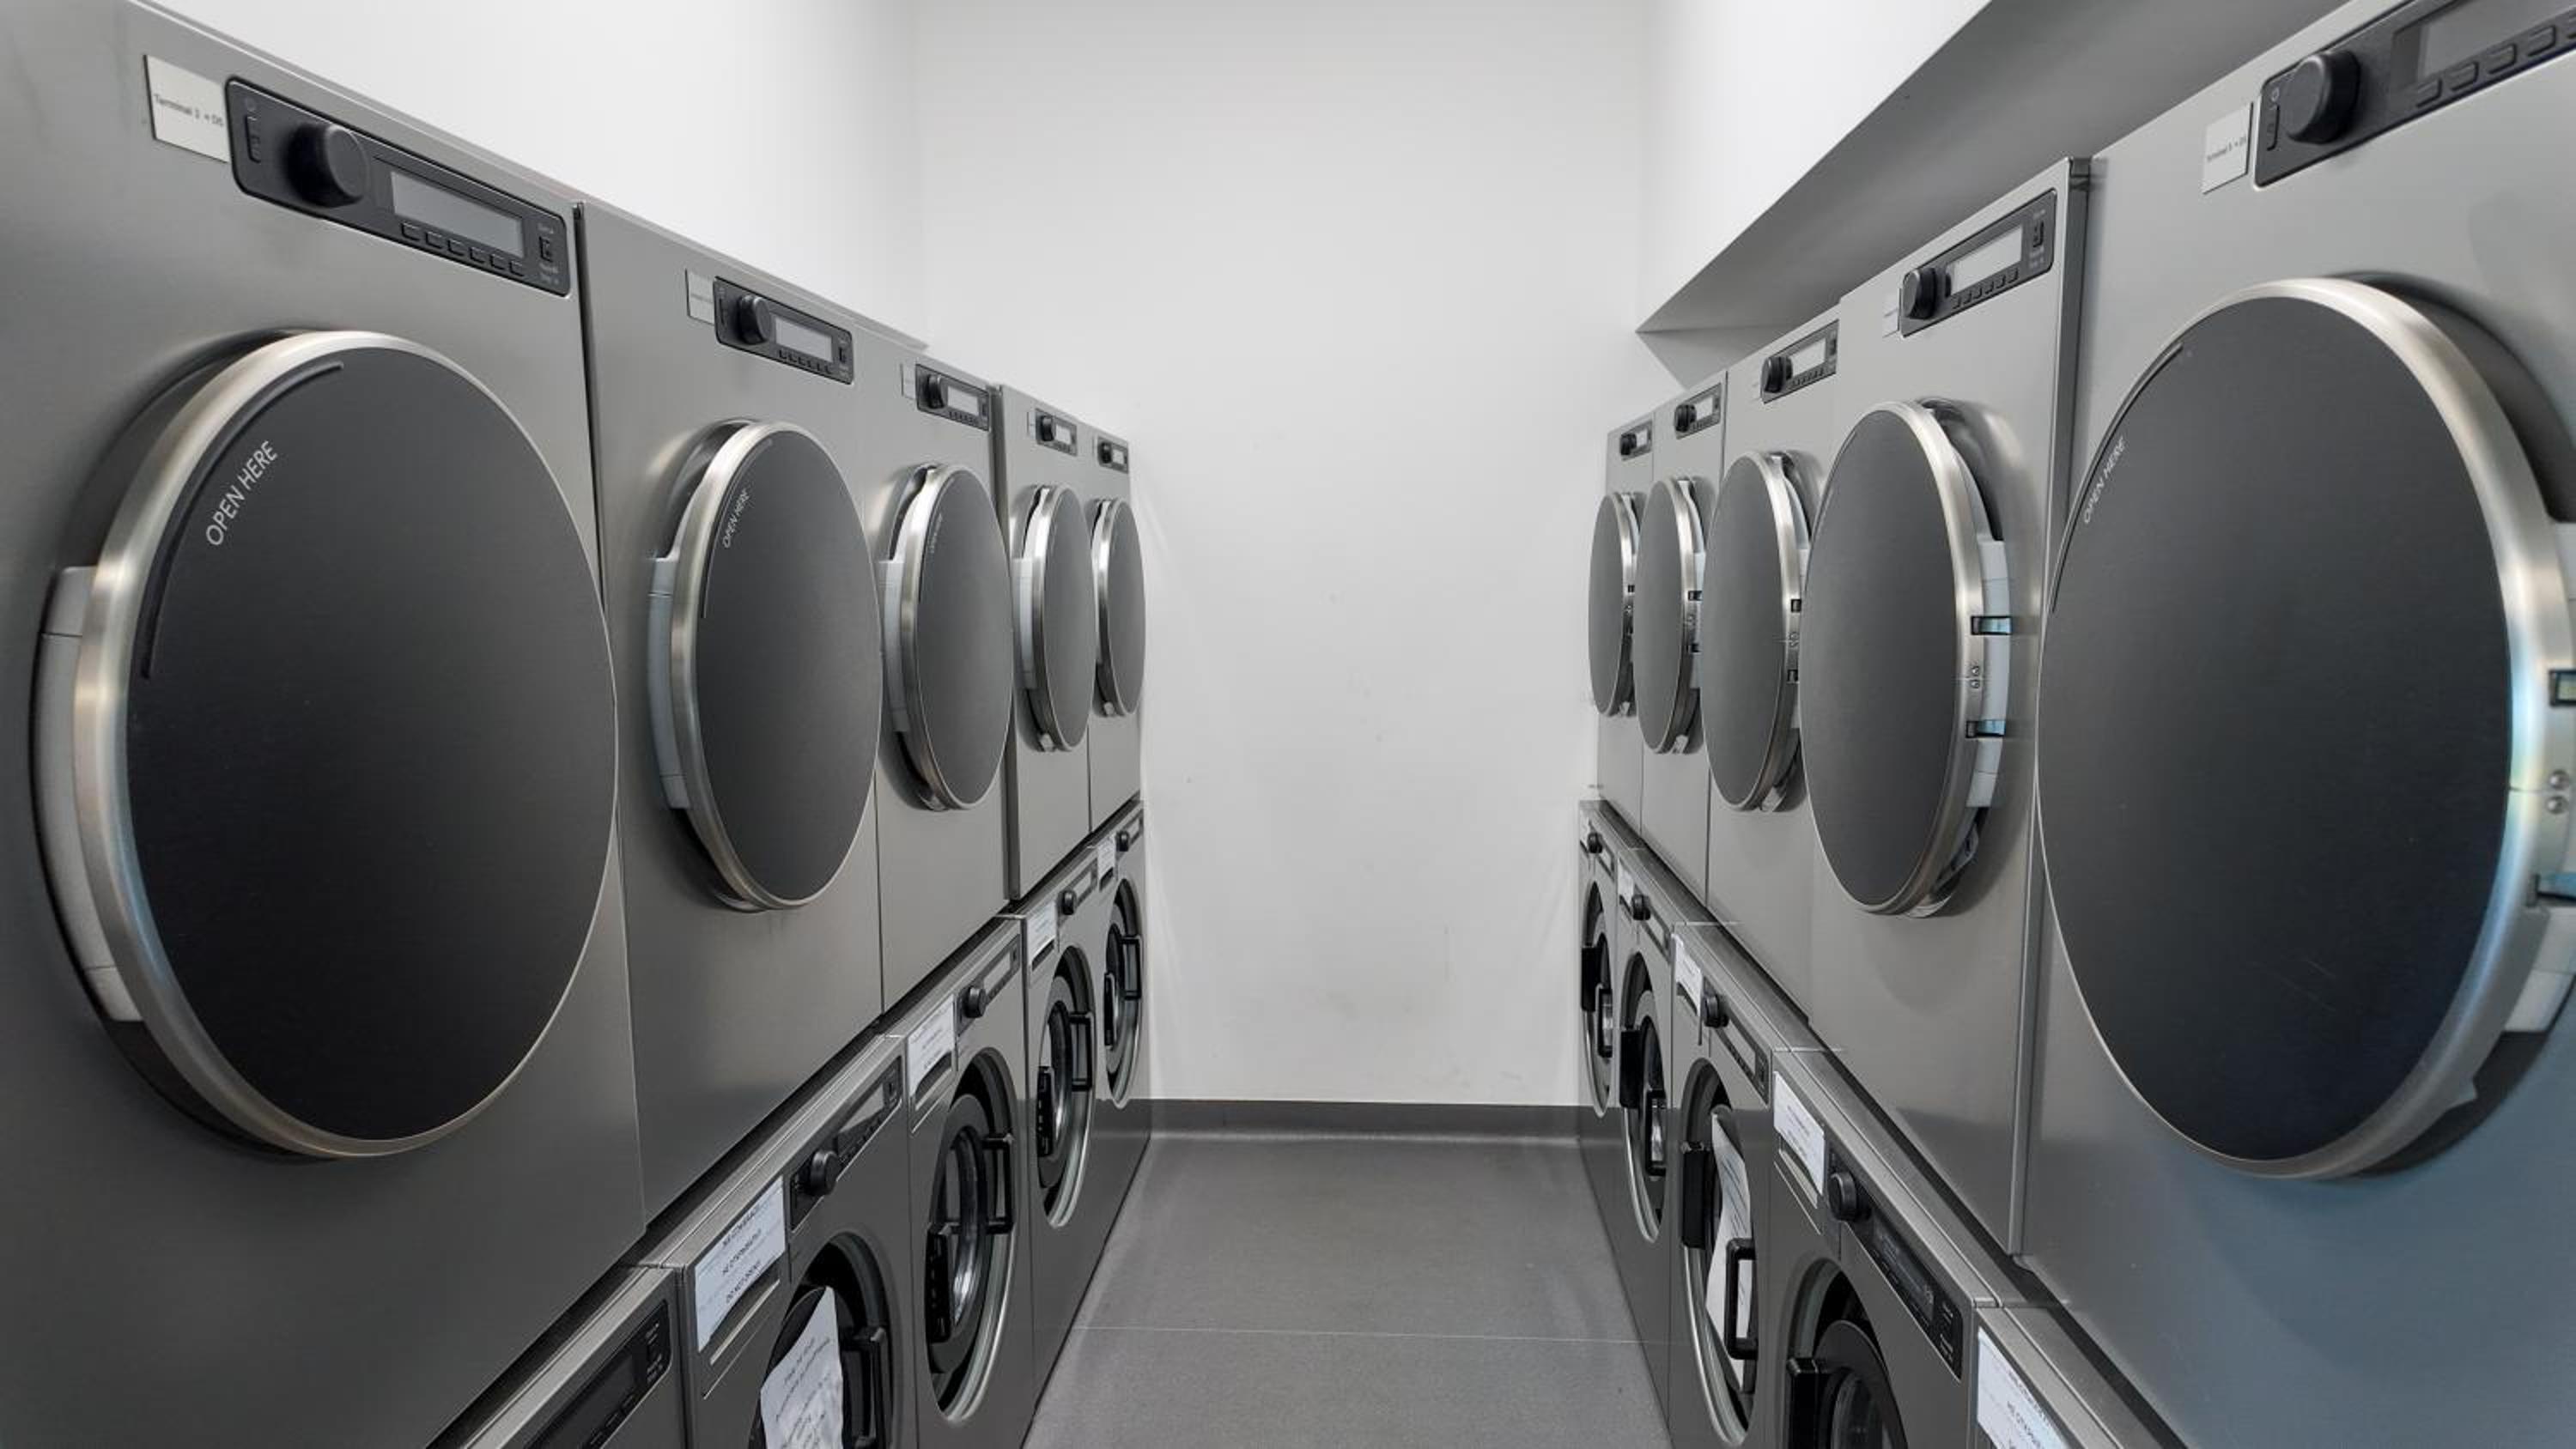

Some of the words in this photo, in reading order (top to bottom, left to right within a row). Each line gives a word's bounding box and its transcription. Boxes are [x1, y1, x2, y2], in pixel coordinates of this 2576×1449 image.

[206, 485, 245, 545] OPEN
[237, 440, 278, 490] HERE
[722, 514, 738, 549] OPEN
[734, 487, 750, 517] HERE
[2084, 477, 2104, 524] OPEN
[2104, 434, 2125, 479] HERE
